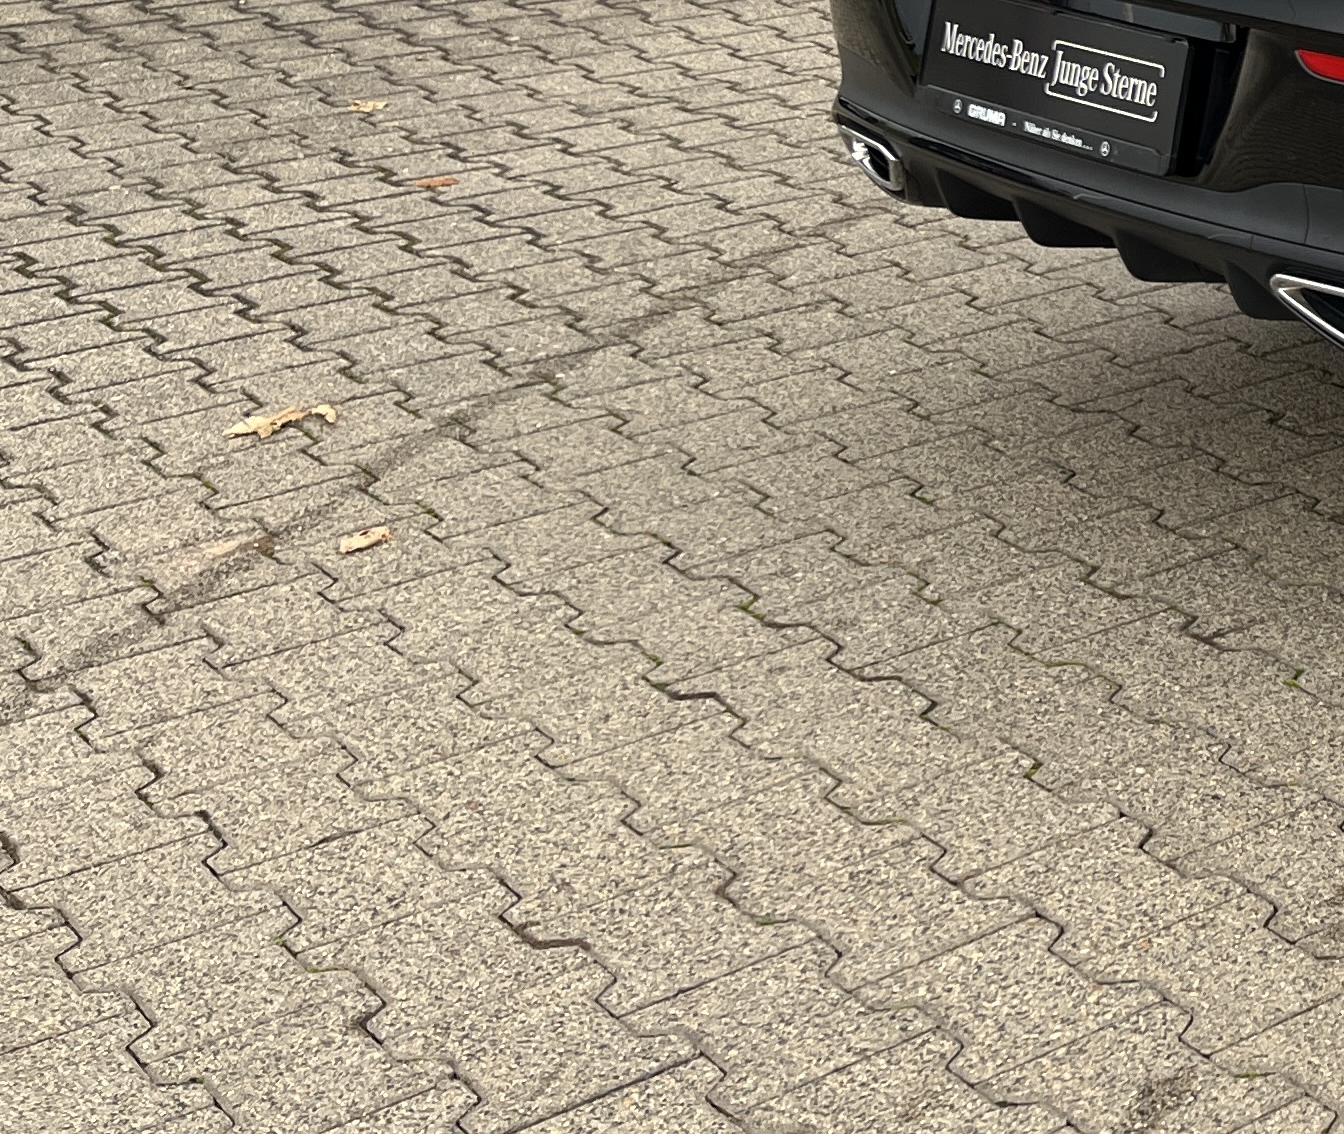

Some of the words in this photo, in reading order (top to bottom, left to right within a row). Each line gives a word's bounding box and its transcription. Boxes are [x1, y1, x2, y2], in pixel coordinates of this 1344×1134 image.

[940, 21, 1048, 79] Mercedes-Benz
[1051, 49, 1099, 96] Junge
[1099, 61, 1158, 107] Sterne
